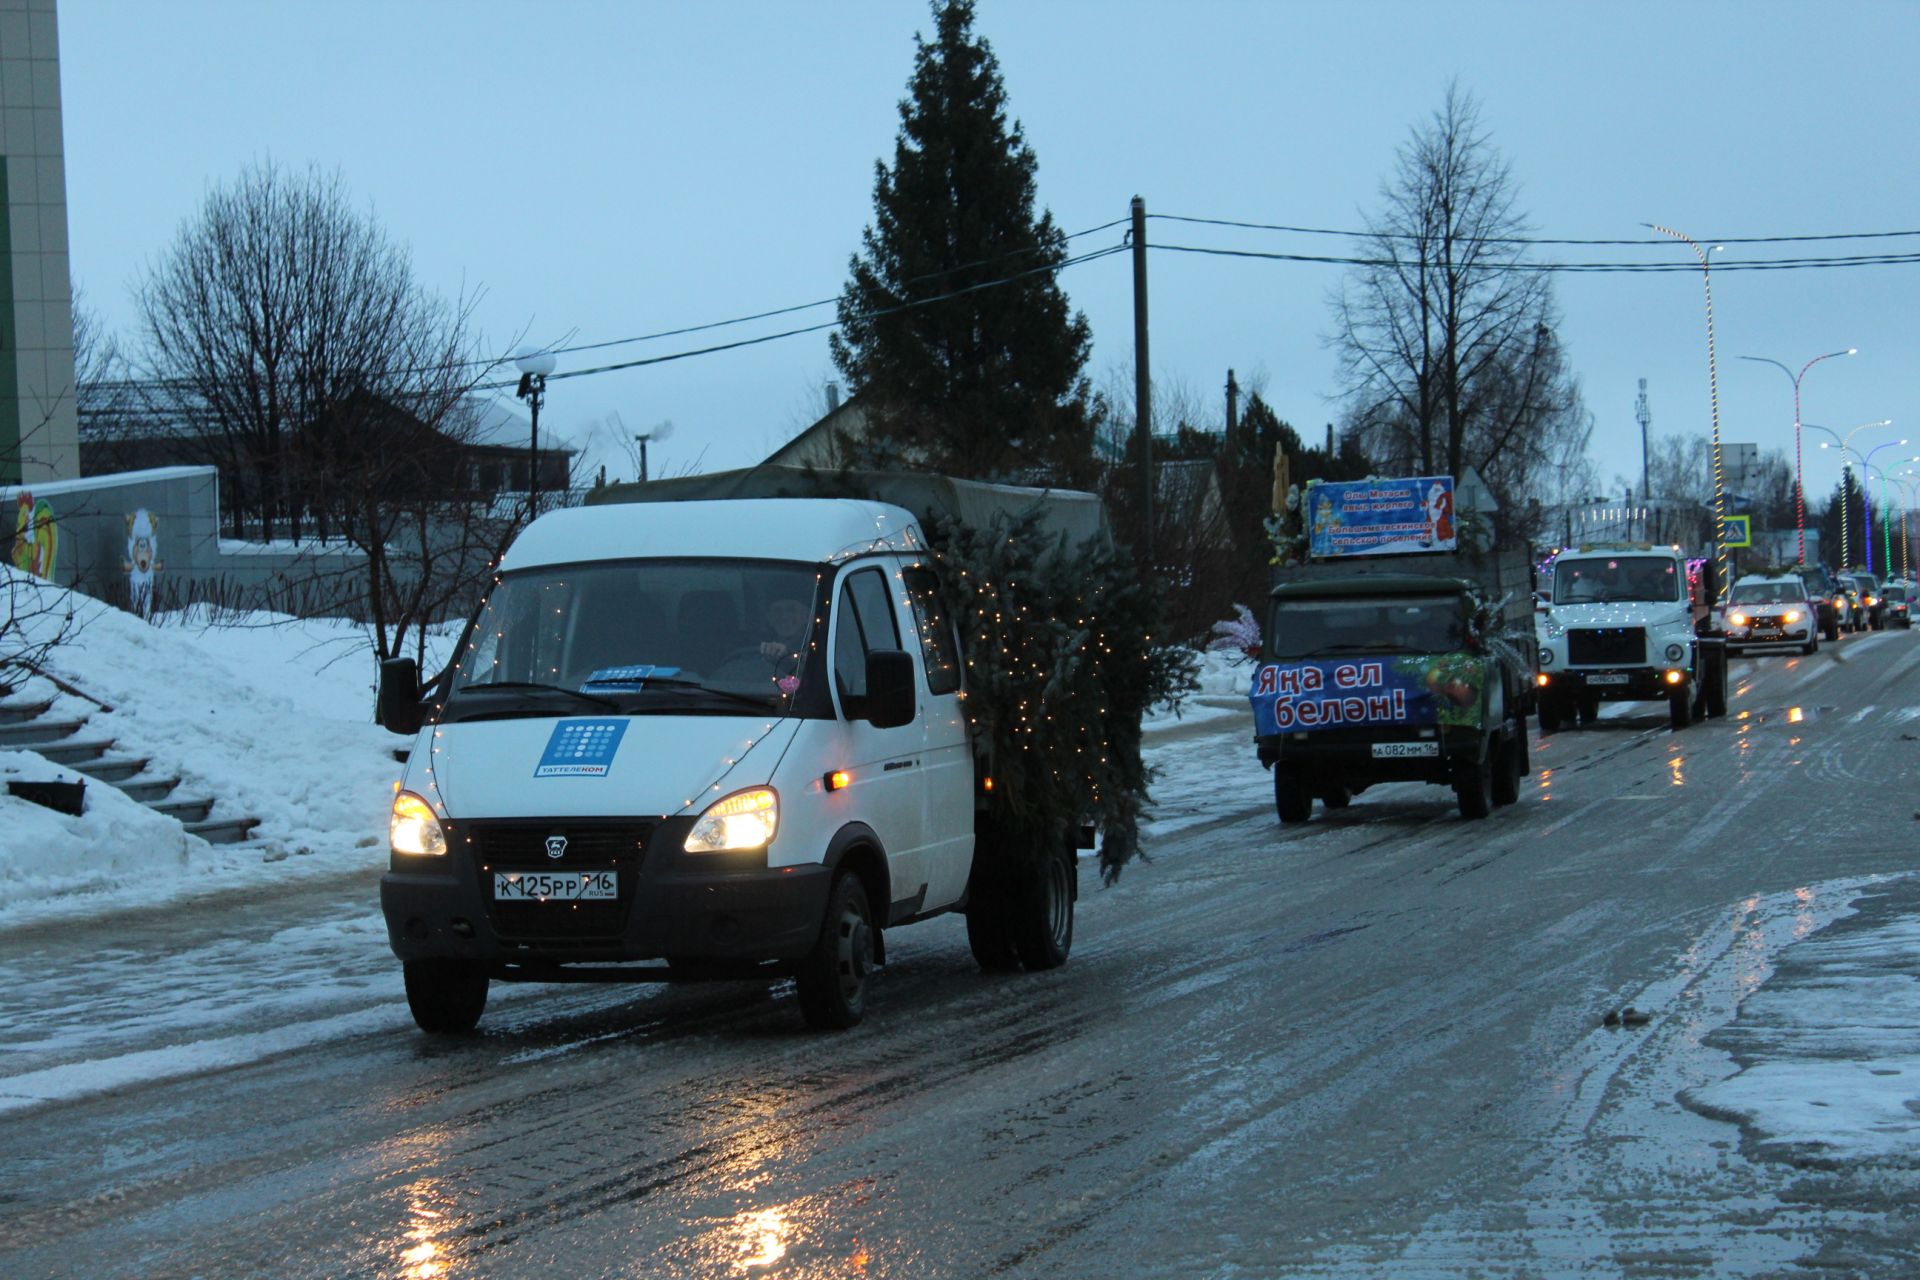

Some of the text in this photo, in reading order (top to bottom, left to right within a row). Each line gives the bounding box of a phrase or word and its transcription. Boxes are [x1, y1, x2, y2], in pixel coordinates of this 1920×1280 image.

[1255, 663, 1383, 696] Яңа ел
[1275, 689, 1406, 728] белән!
